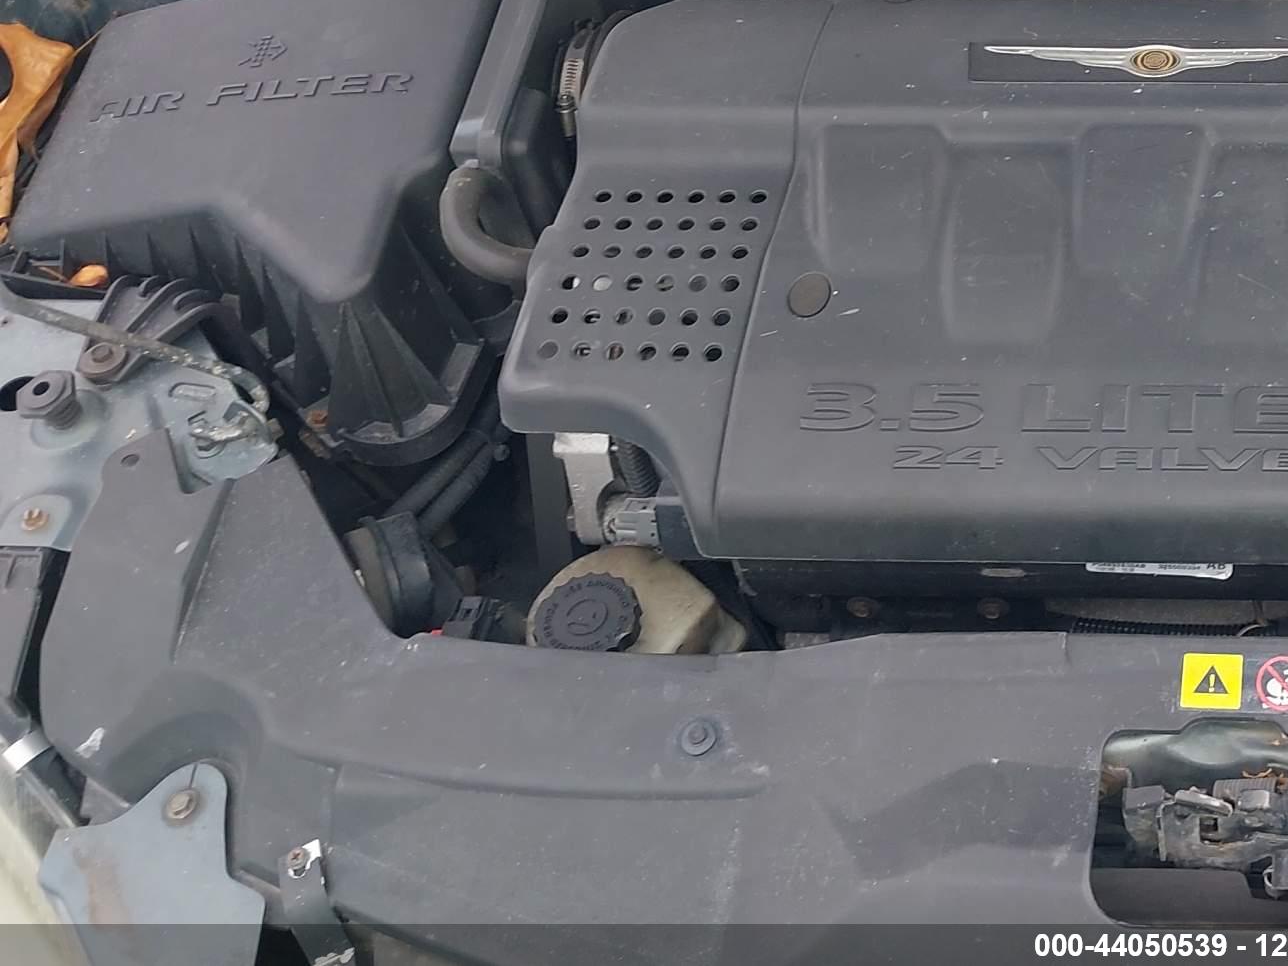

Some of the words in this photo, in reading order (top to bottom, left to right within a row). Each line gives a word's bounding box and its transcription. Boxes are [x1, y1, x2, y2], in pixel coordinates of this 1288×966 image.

[88, 90, 185, 123] AIR
[206, 73, 414, 107] FILTER
[800, 383, 985, 432] 3.5
[893, 445, 1003, 471] 24
